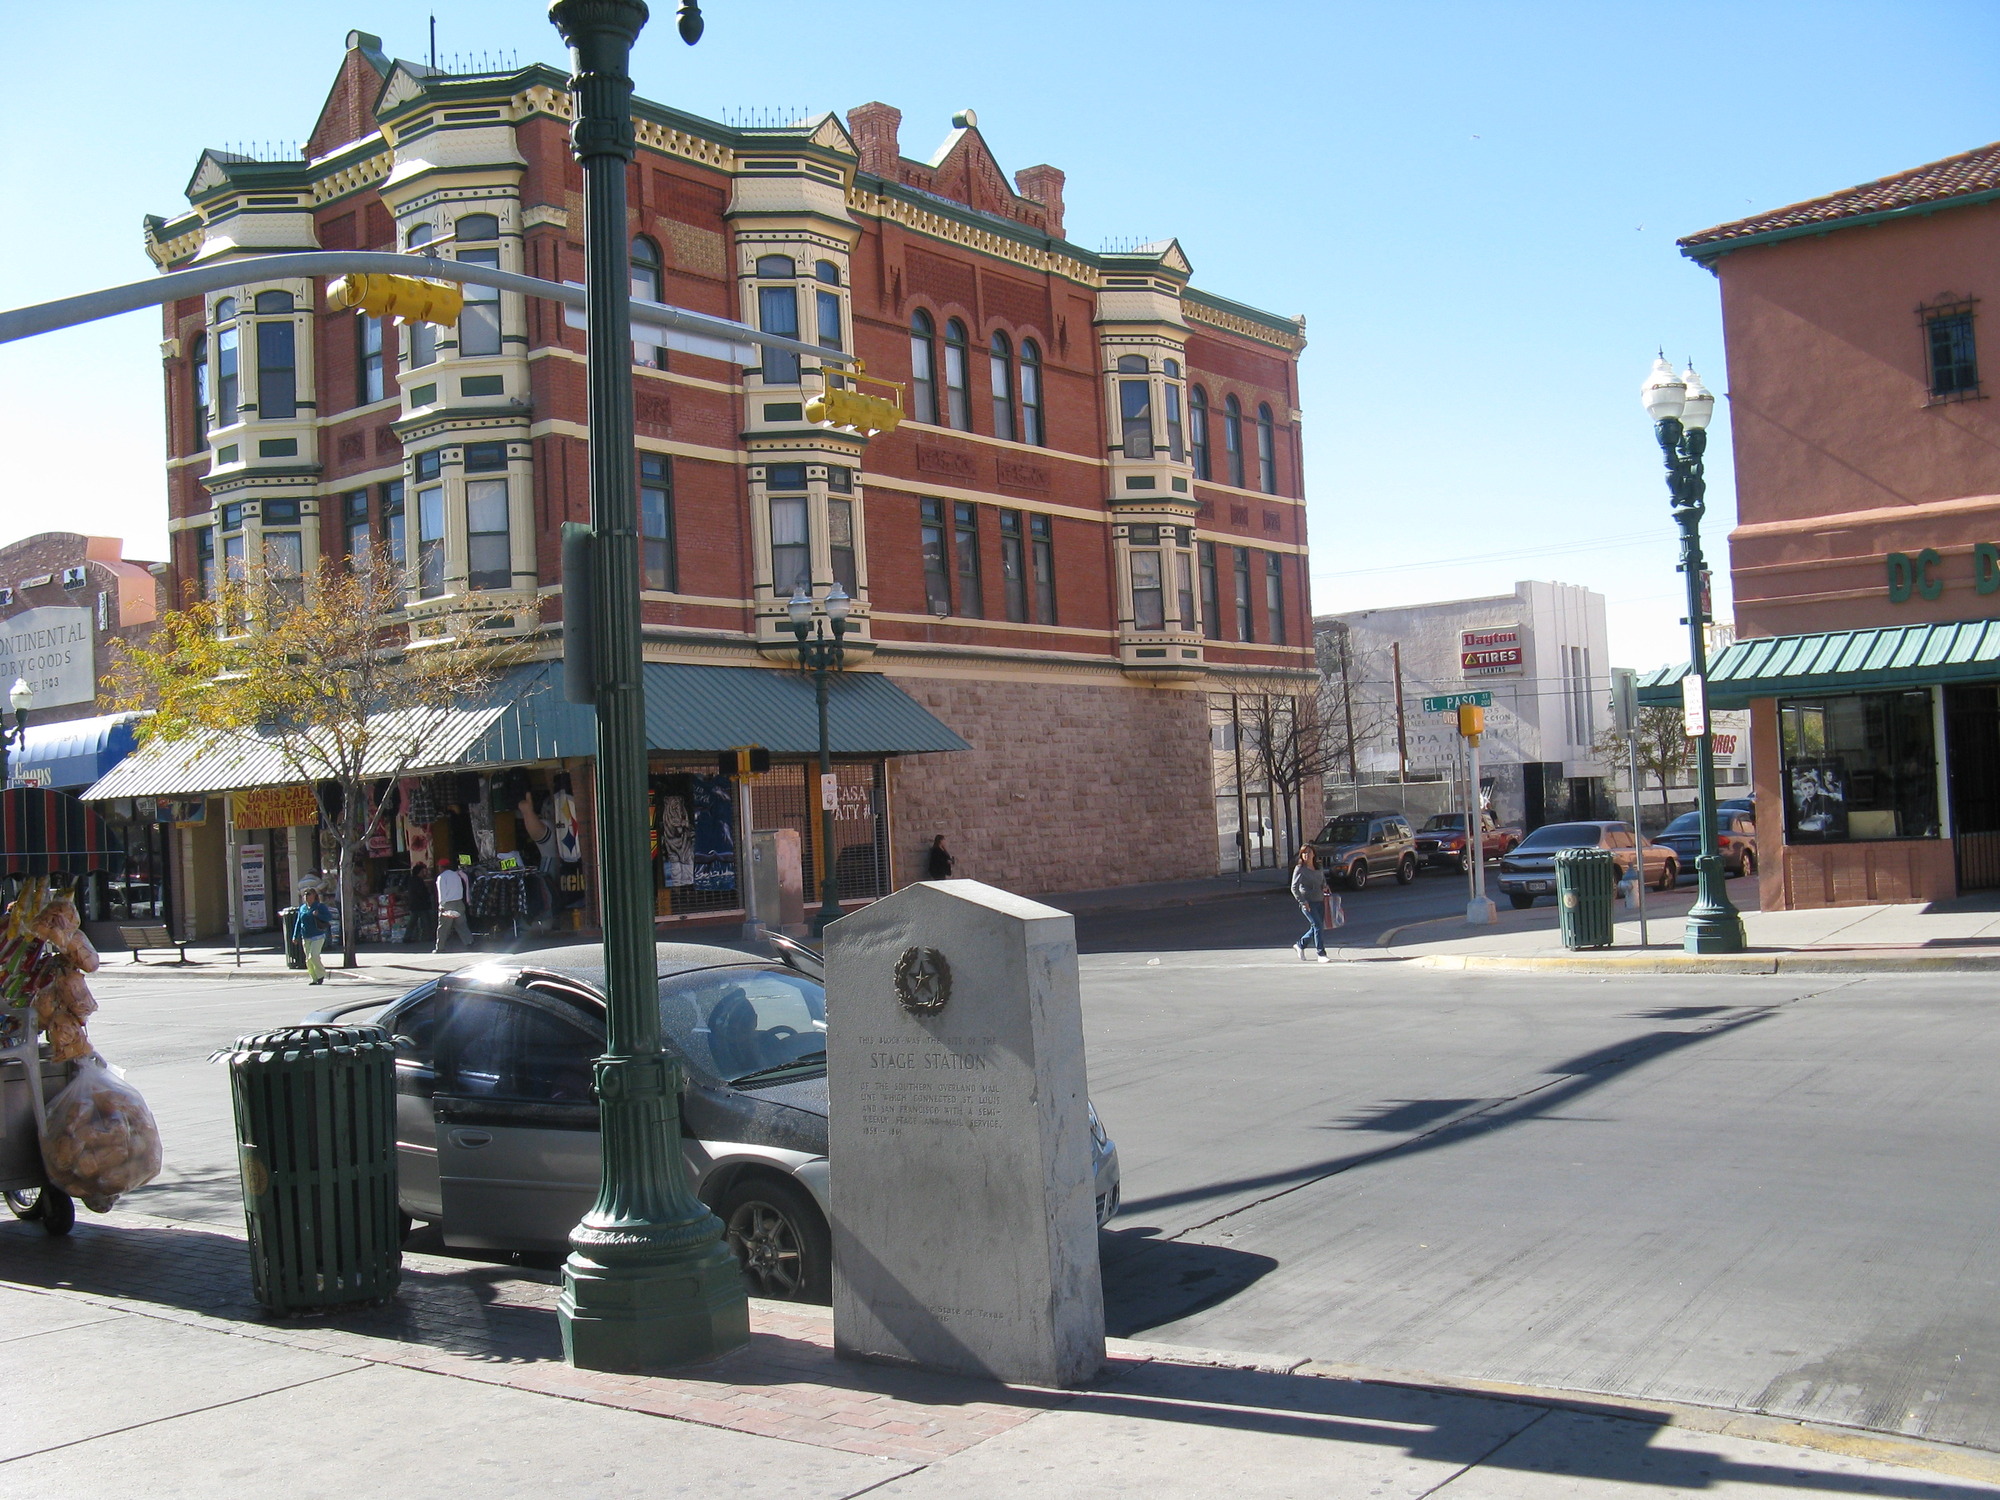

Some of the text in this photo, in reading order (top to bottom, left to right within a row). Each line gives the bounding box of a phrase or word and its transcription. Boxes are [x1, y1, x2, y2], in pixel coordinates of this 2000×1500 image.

[1887, 548, 1943, 603] DC
[1463, 632, 1517, 646] Dayton
[1477, 651, 1517, 664] TIRES
[1480, 667, 1506, 675] LLANTAS
[1424, 695, 1476, 711] EL PASO
[247, 786, 314, 803] OASIS CAFE
[268, 799, 317, 810] 544-5544
[831, 804, 860, 820] ATY
[295, 807, 318, 825] MEXIC
[871, 1053, 986, 1071] STAGE STATION
[875, 1082, 889, 1091] THE
[939, 1084, 976, 1093] OVERLAND
